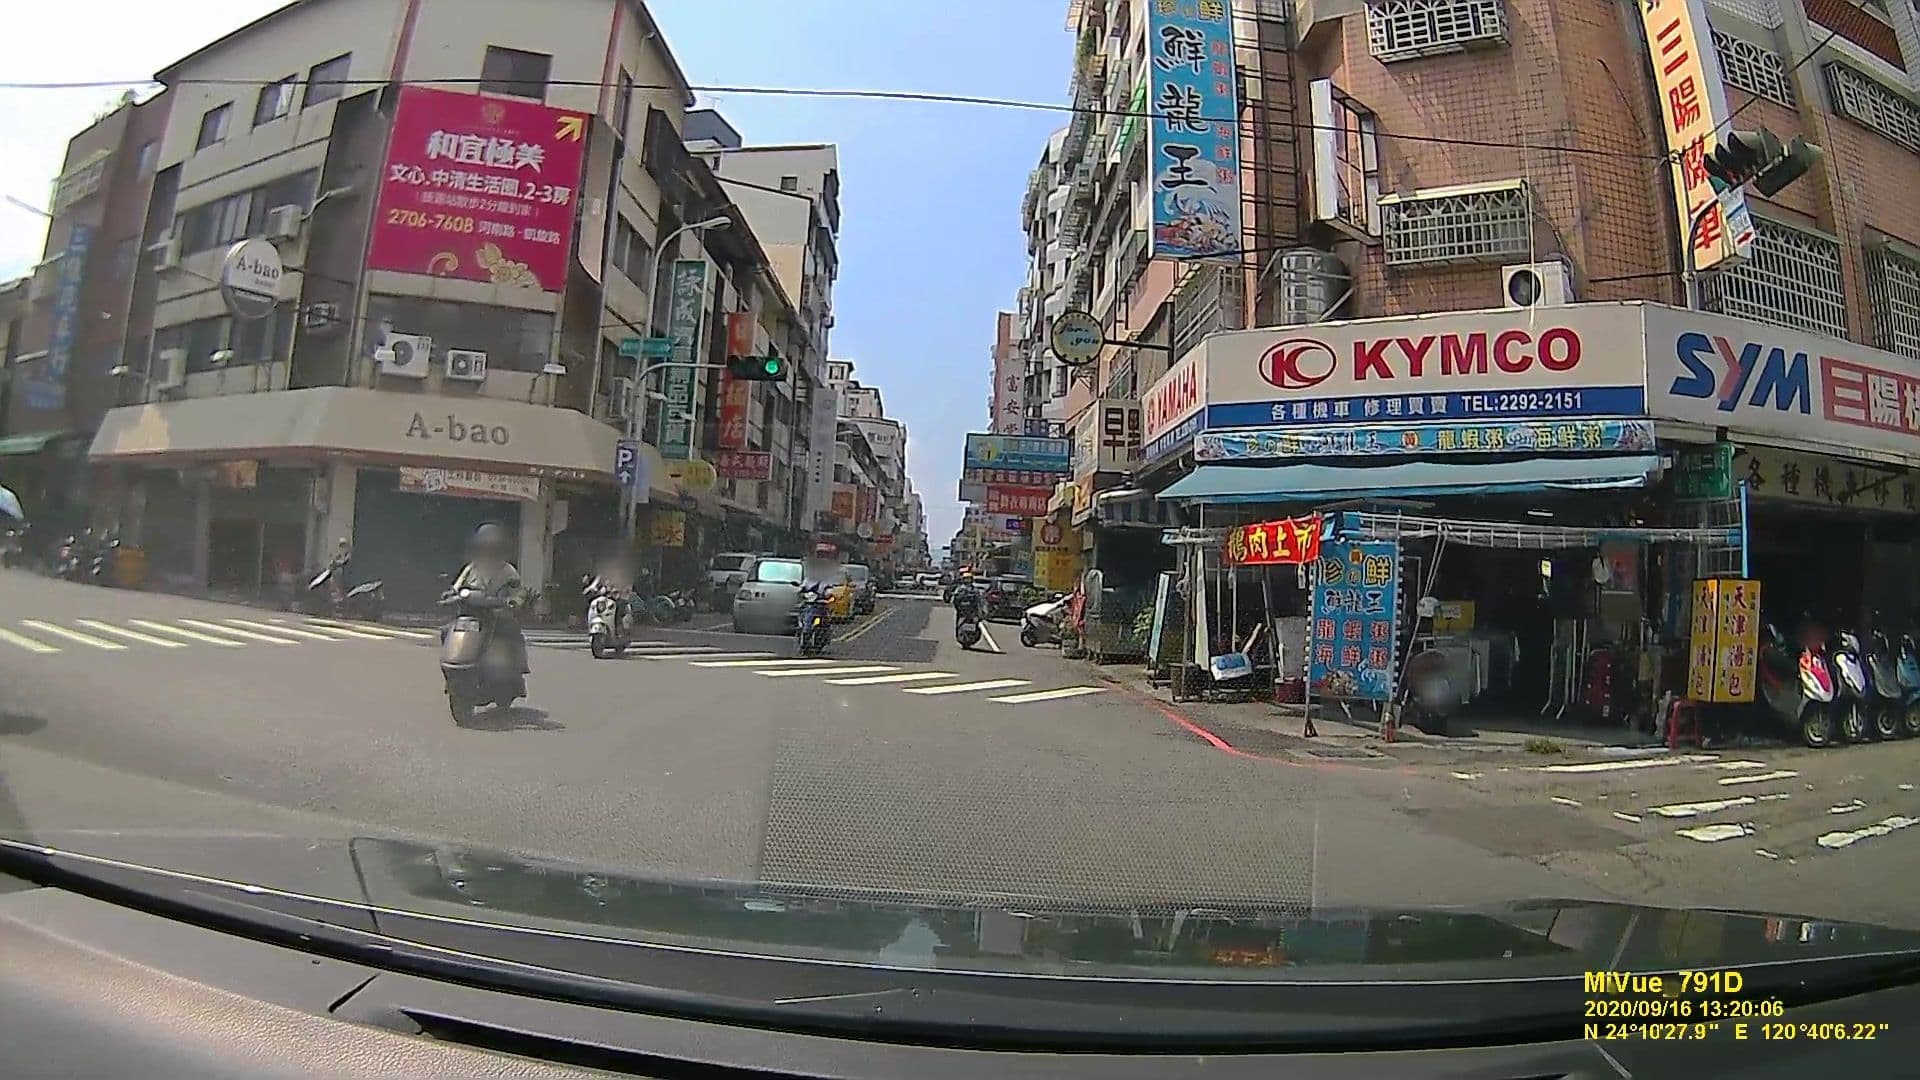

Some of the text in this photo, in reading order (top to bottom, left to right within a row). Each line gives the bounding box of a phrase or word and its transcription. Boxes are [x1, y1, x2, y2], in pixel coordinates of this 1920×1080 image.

[1155, 26, 1210, 188] 鮮龍王
[426, 130, 545, 173] 和宜極美
[387, 209, 475, 233] 2706-7608
[235, 257, 280, 280] A-bao
[1353, 328, 1582, 381] KYMCO
[1669, 332, 1811, 415] SYM
[1157, 361, 1198, 428] YAMAHA
[1271, 401, 1350, 421] 各種機車
[1461, 391, 1582, 412] TEL:2292-2151
[405, 411, 511, 446] A-bao
[618, 449, 633, 468] P
[1728, 585, 1747, 697] 天津湯包
